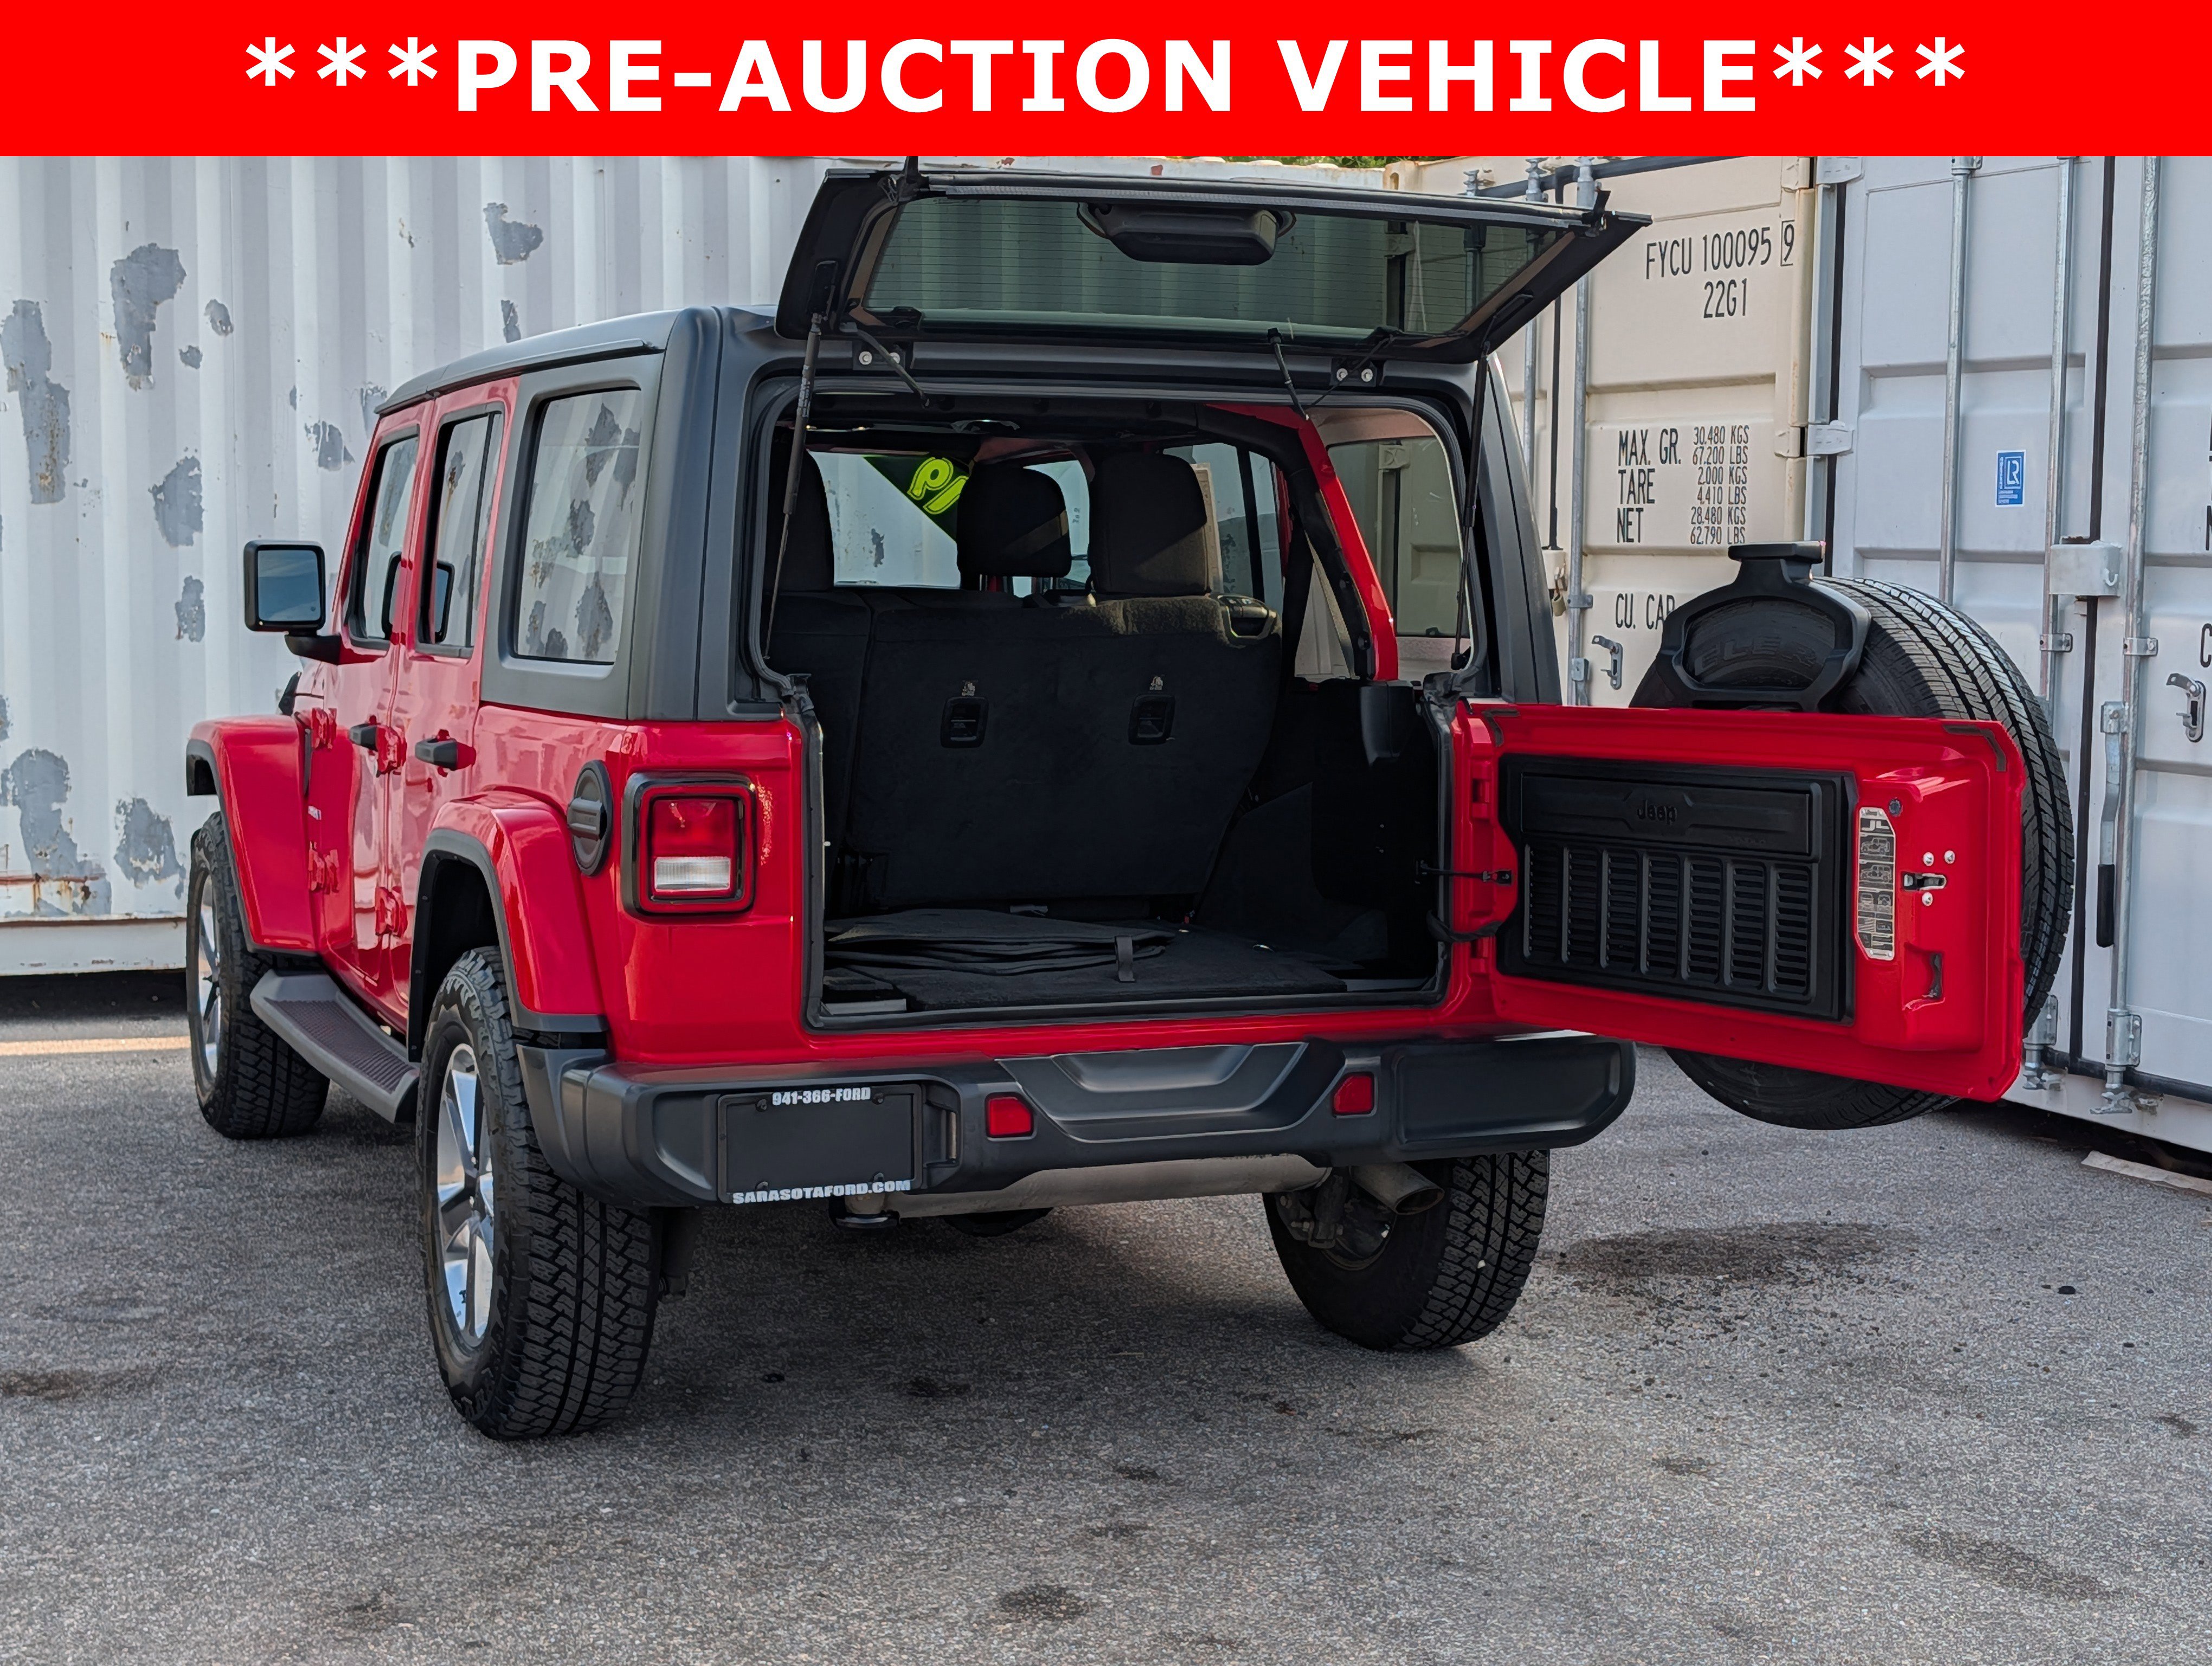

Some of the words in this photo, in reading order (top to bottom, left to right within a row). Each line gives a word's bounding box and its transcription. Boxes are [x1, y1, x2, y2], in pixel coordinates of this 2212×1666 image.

[1646, 237, 1692, 280] FYCU
[1702, 227, 1772, 272] 100095
[1784, 223, 1795, 263] 9
[1703, 278, 1747, 319] 22G1
[1618, 430, 1651, 466] MAX.
[1659, 428, 1681, 465] GR.
[1693, 426, 1726, 445] 30.480
[1731, 425, 1750, 444] KGS
[1693, 446, 1725, 465] 67.200
[1729, 445, 1748, 464] LBS
[1618, 468, 1655, 504] TARE
[1697, 466, 1724, 485] 2.000
[1729, 465, 1747, 485] KGS
[1697, 486, 1723, 504] 4.410
[1728, 486, 1747, 504] LBS
[1617, 507, 1644, 543] NET
[1690, 506, 1722, 525] 28.480
[1727, 506, 1746, 525] KGS
[1690, 526, 1722, 545] 62.790
[1727, 526, 1745, 545] LBS
[1615, 593, 1636, 629] CU.
[1637, 799, 1678, 826] Jeep
[772, 1087, 871, 1106] 941-366-FORD
[732, 1180, 911, 1204] SARASOTAFORD.COM
